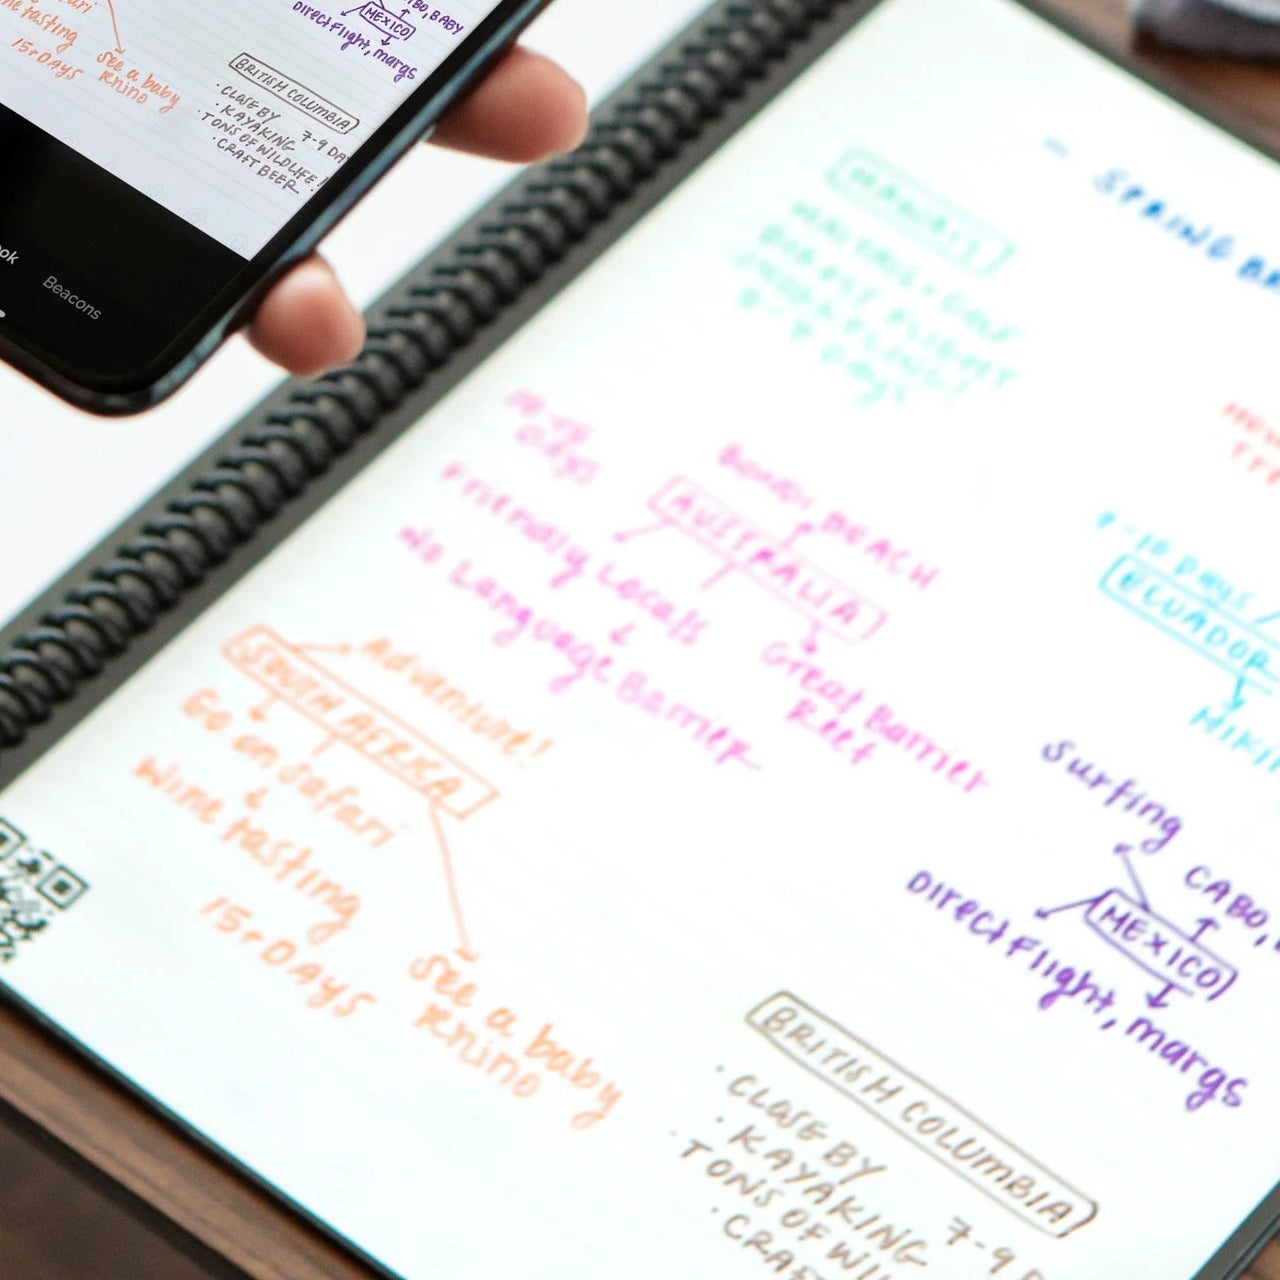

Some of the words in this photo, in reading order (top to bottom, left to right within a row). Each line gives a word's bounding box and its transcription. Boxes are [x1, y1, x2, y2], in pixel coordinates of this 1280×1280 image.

[364, 7, 411, 37] MEXICO
[429, 10, 464, 36] BABY
[373, 48, 418, 83] margs
[141, 73, 181, 114] baby
[220, 86, 260, 109] CLOSE
[256, 107, 282, 124] BY
[235, 58, 289, 93] BRITISH
[287, 88, 350, 130] COLUMBIA
[201, 112, 242, 137] TONS
[239, 134, 258, 149] OF
[216, 138, 261, 169] CRAFT
[220, 104, 295, 153] KAYAKING
[302, 130, 328, 151] 7-9
[327, 146, 350, 164] DA
[1092, 168, 1236, 261] SPRING
[42, 275, 102, 320] Beacons
[1098, 902, 1223, 991] MEXICO
[524, 1022, 624, 1132] baby
[1125, 1014, 1250, 1113] margs
[726, 1072, 828, 1141] CLOSE
[824, 1140, 888, 1187] BY
[762, 1005, 906, 1104] BRITISH
[901, 1100, 1075, 1224] COLUMBIA
[679, 1138, 785, 1208] TONS
[780, 1207, 831, 1242] OF
[727, 1124, 928, 1267] KAYAKING
[947, 1216, 1018, 1276] 7-9
